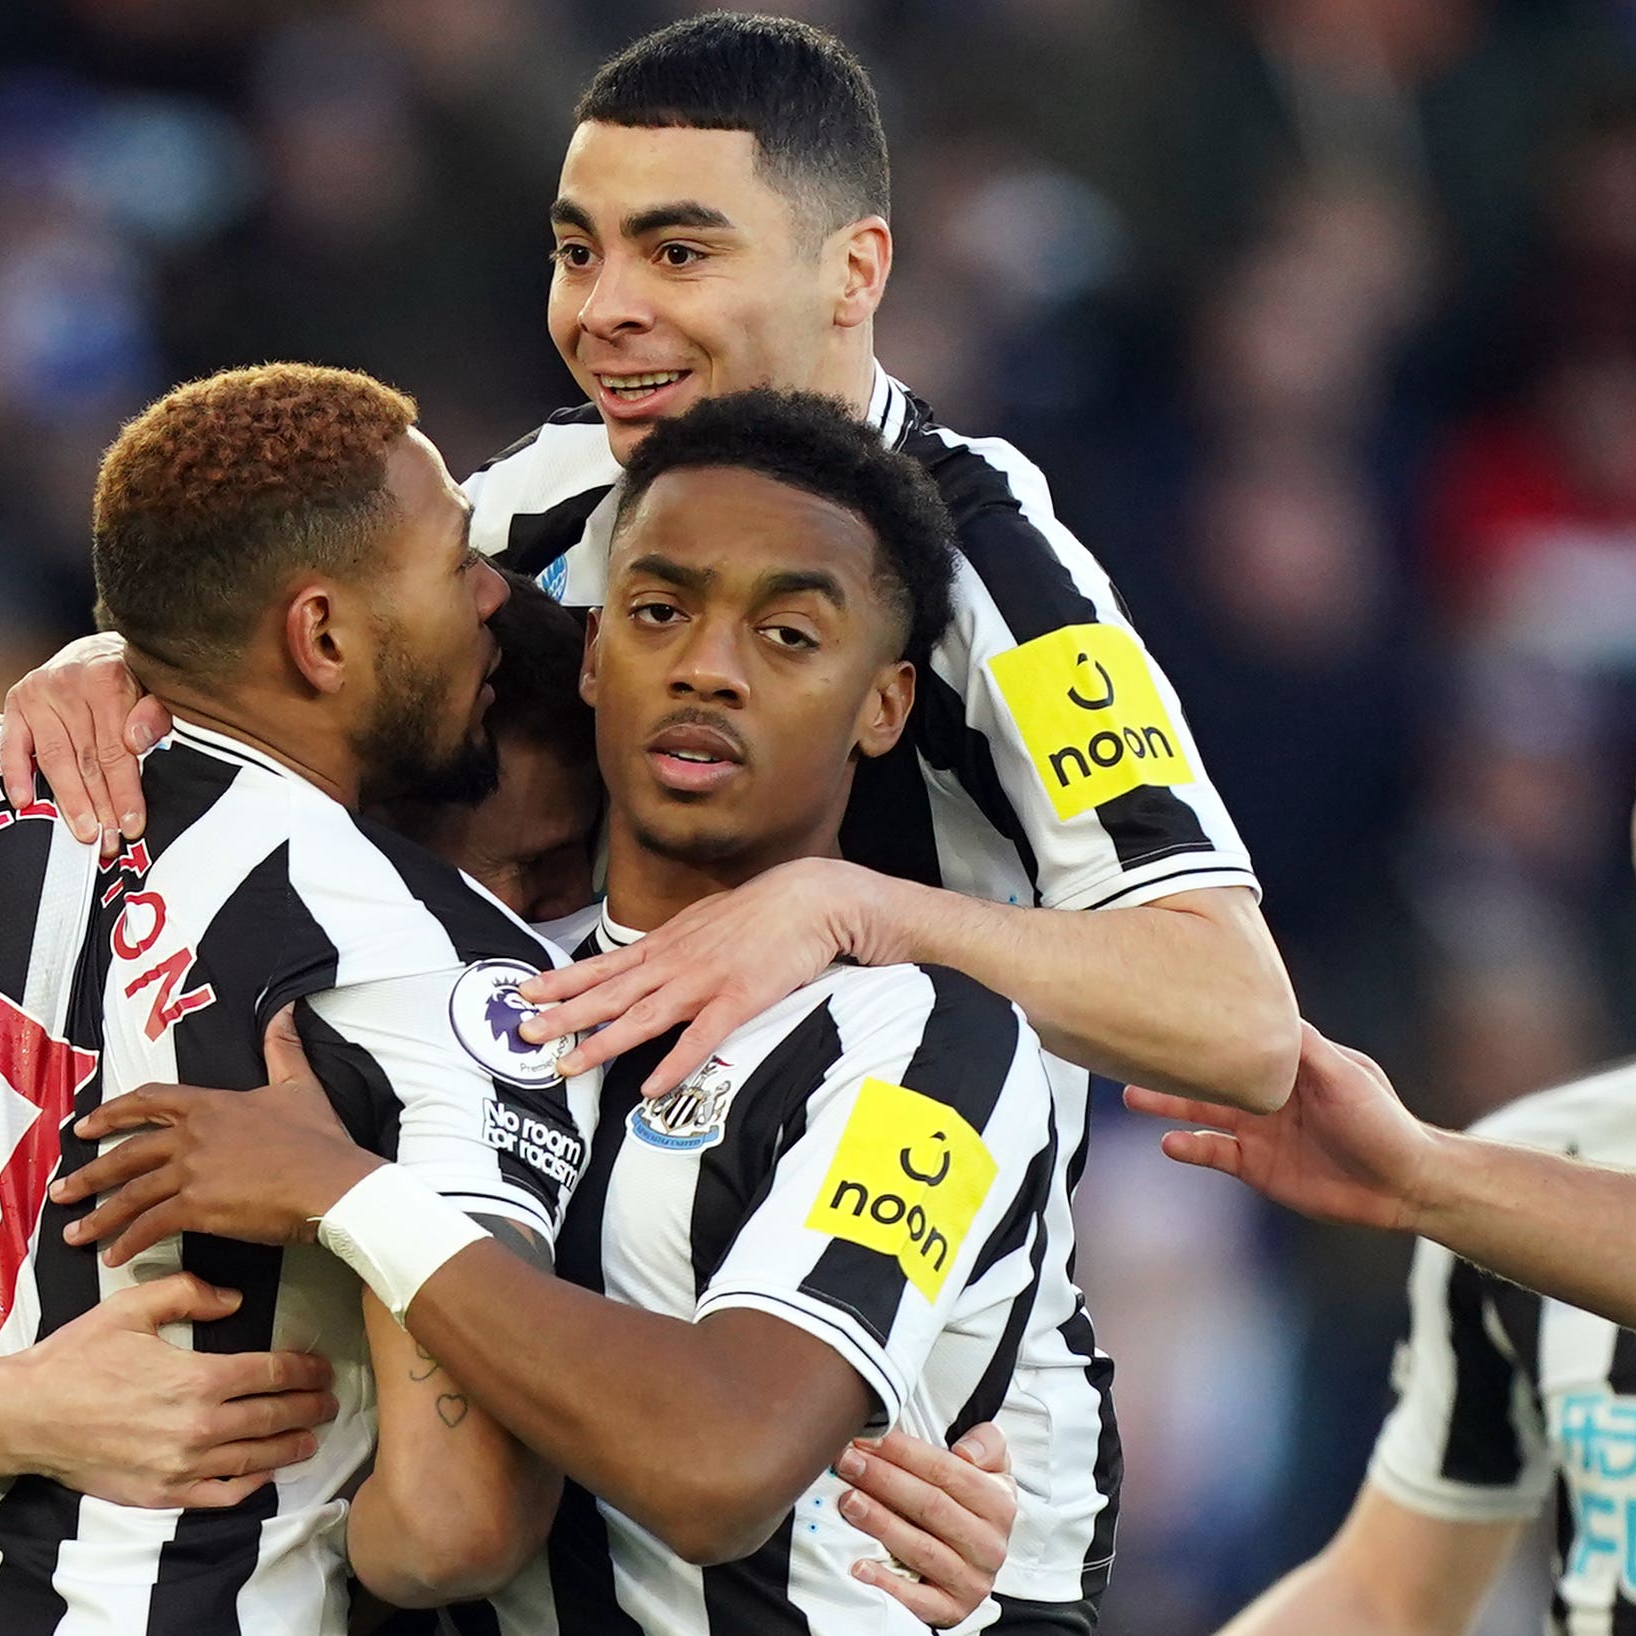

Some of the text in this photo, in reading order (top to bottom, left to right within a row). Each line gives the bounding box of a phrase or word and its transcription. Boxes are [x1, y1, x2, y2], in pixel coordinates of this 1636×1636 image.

[1048, 726, 1174, 788] noon
[520, 1058, 554, 1073] Premier
[485, 1099, 581, 1165] No room
[519, 1139, 578, 1192] racism
[830, 1180, 937, 1272] noon
